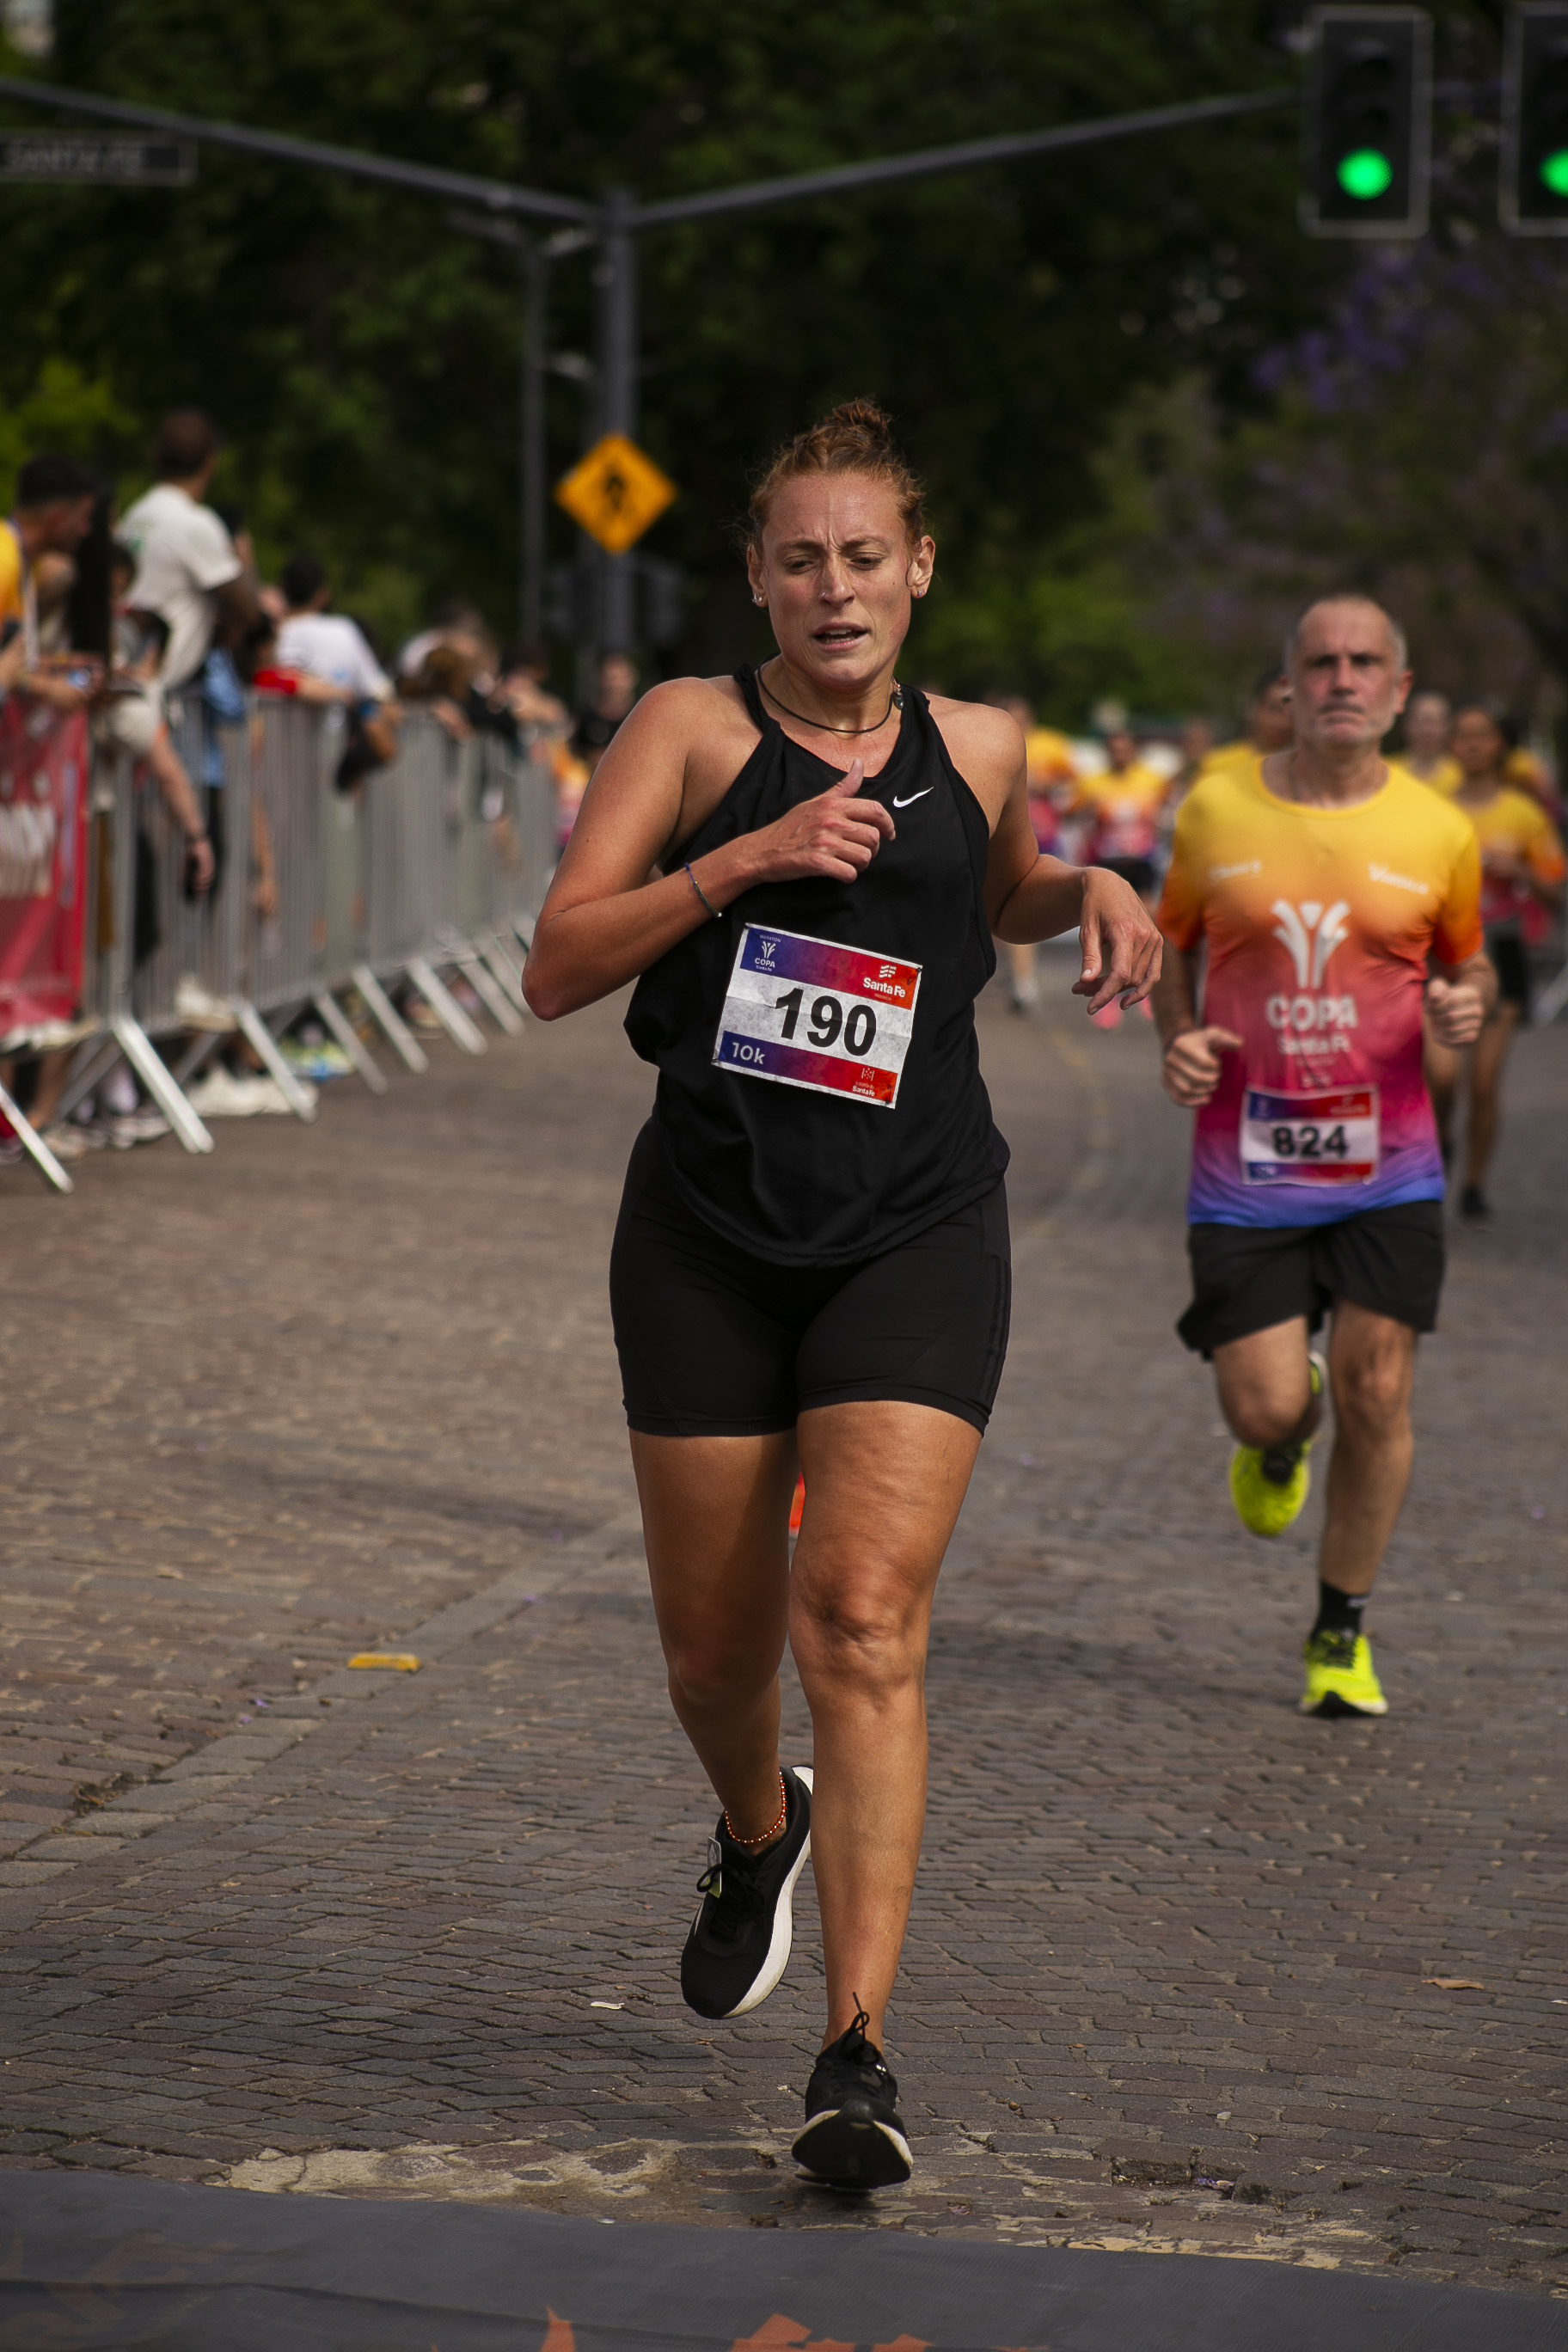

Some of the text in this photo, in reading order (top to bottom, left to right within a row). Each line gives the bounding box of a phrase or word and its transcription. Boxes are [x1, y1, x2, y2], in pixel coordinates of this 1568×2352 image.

[755, 958, 775, 968] COPA
[863, 977, 906, 998] Santa Fe
[775, 987, 877, 1057] 190
[1266, 994, 1358, 1030] COPA
[732, 1042, 765, 1065] 10k
[852, 1086, 869, 1095] Santa
[1272, 1125, 1348, 1159] 824
